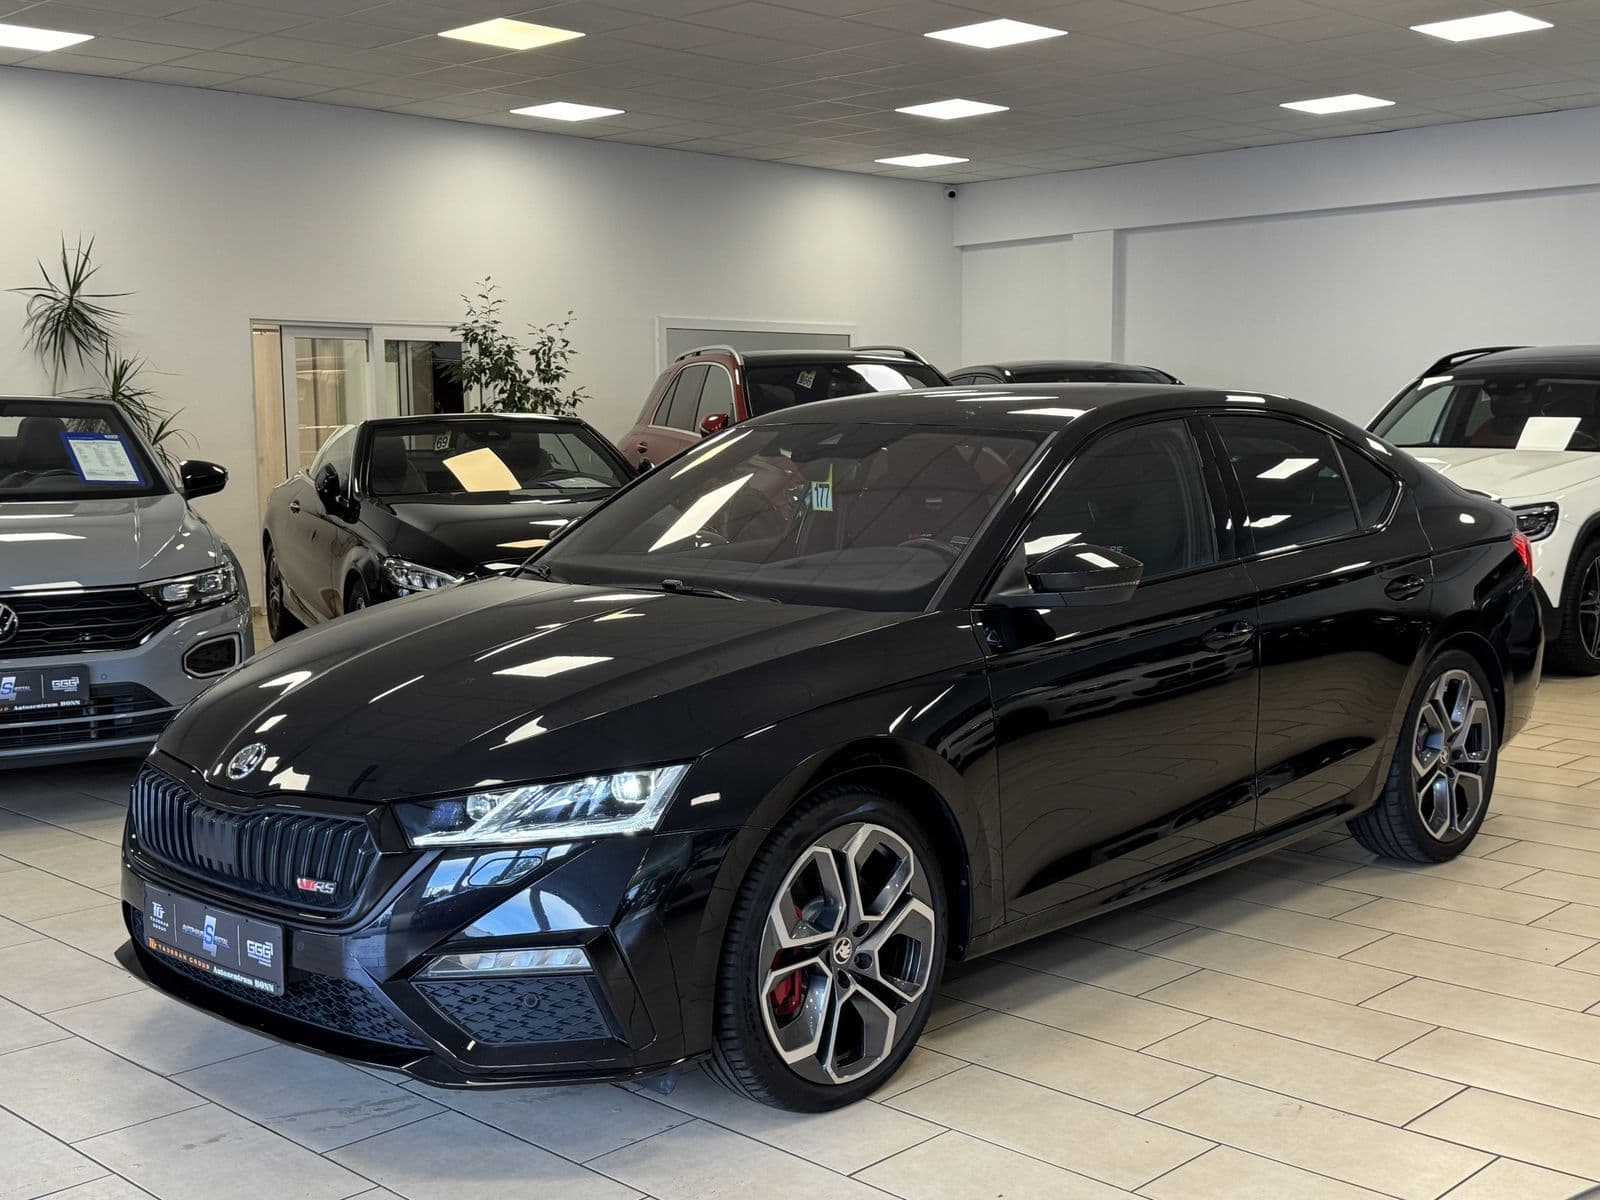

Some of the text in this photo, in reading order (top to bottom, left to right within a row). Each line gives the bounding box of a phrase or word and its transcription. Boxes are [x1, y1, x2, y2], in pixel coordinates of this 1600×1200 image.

[815, 482, 830, 508] 177
[60, 699, 81, 707] BONN
[189, 956, 210, 970] GROUP
[254, 979, 274, 993] BONN
